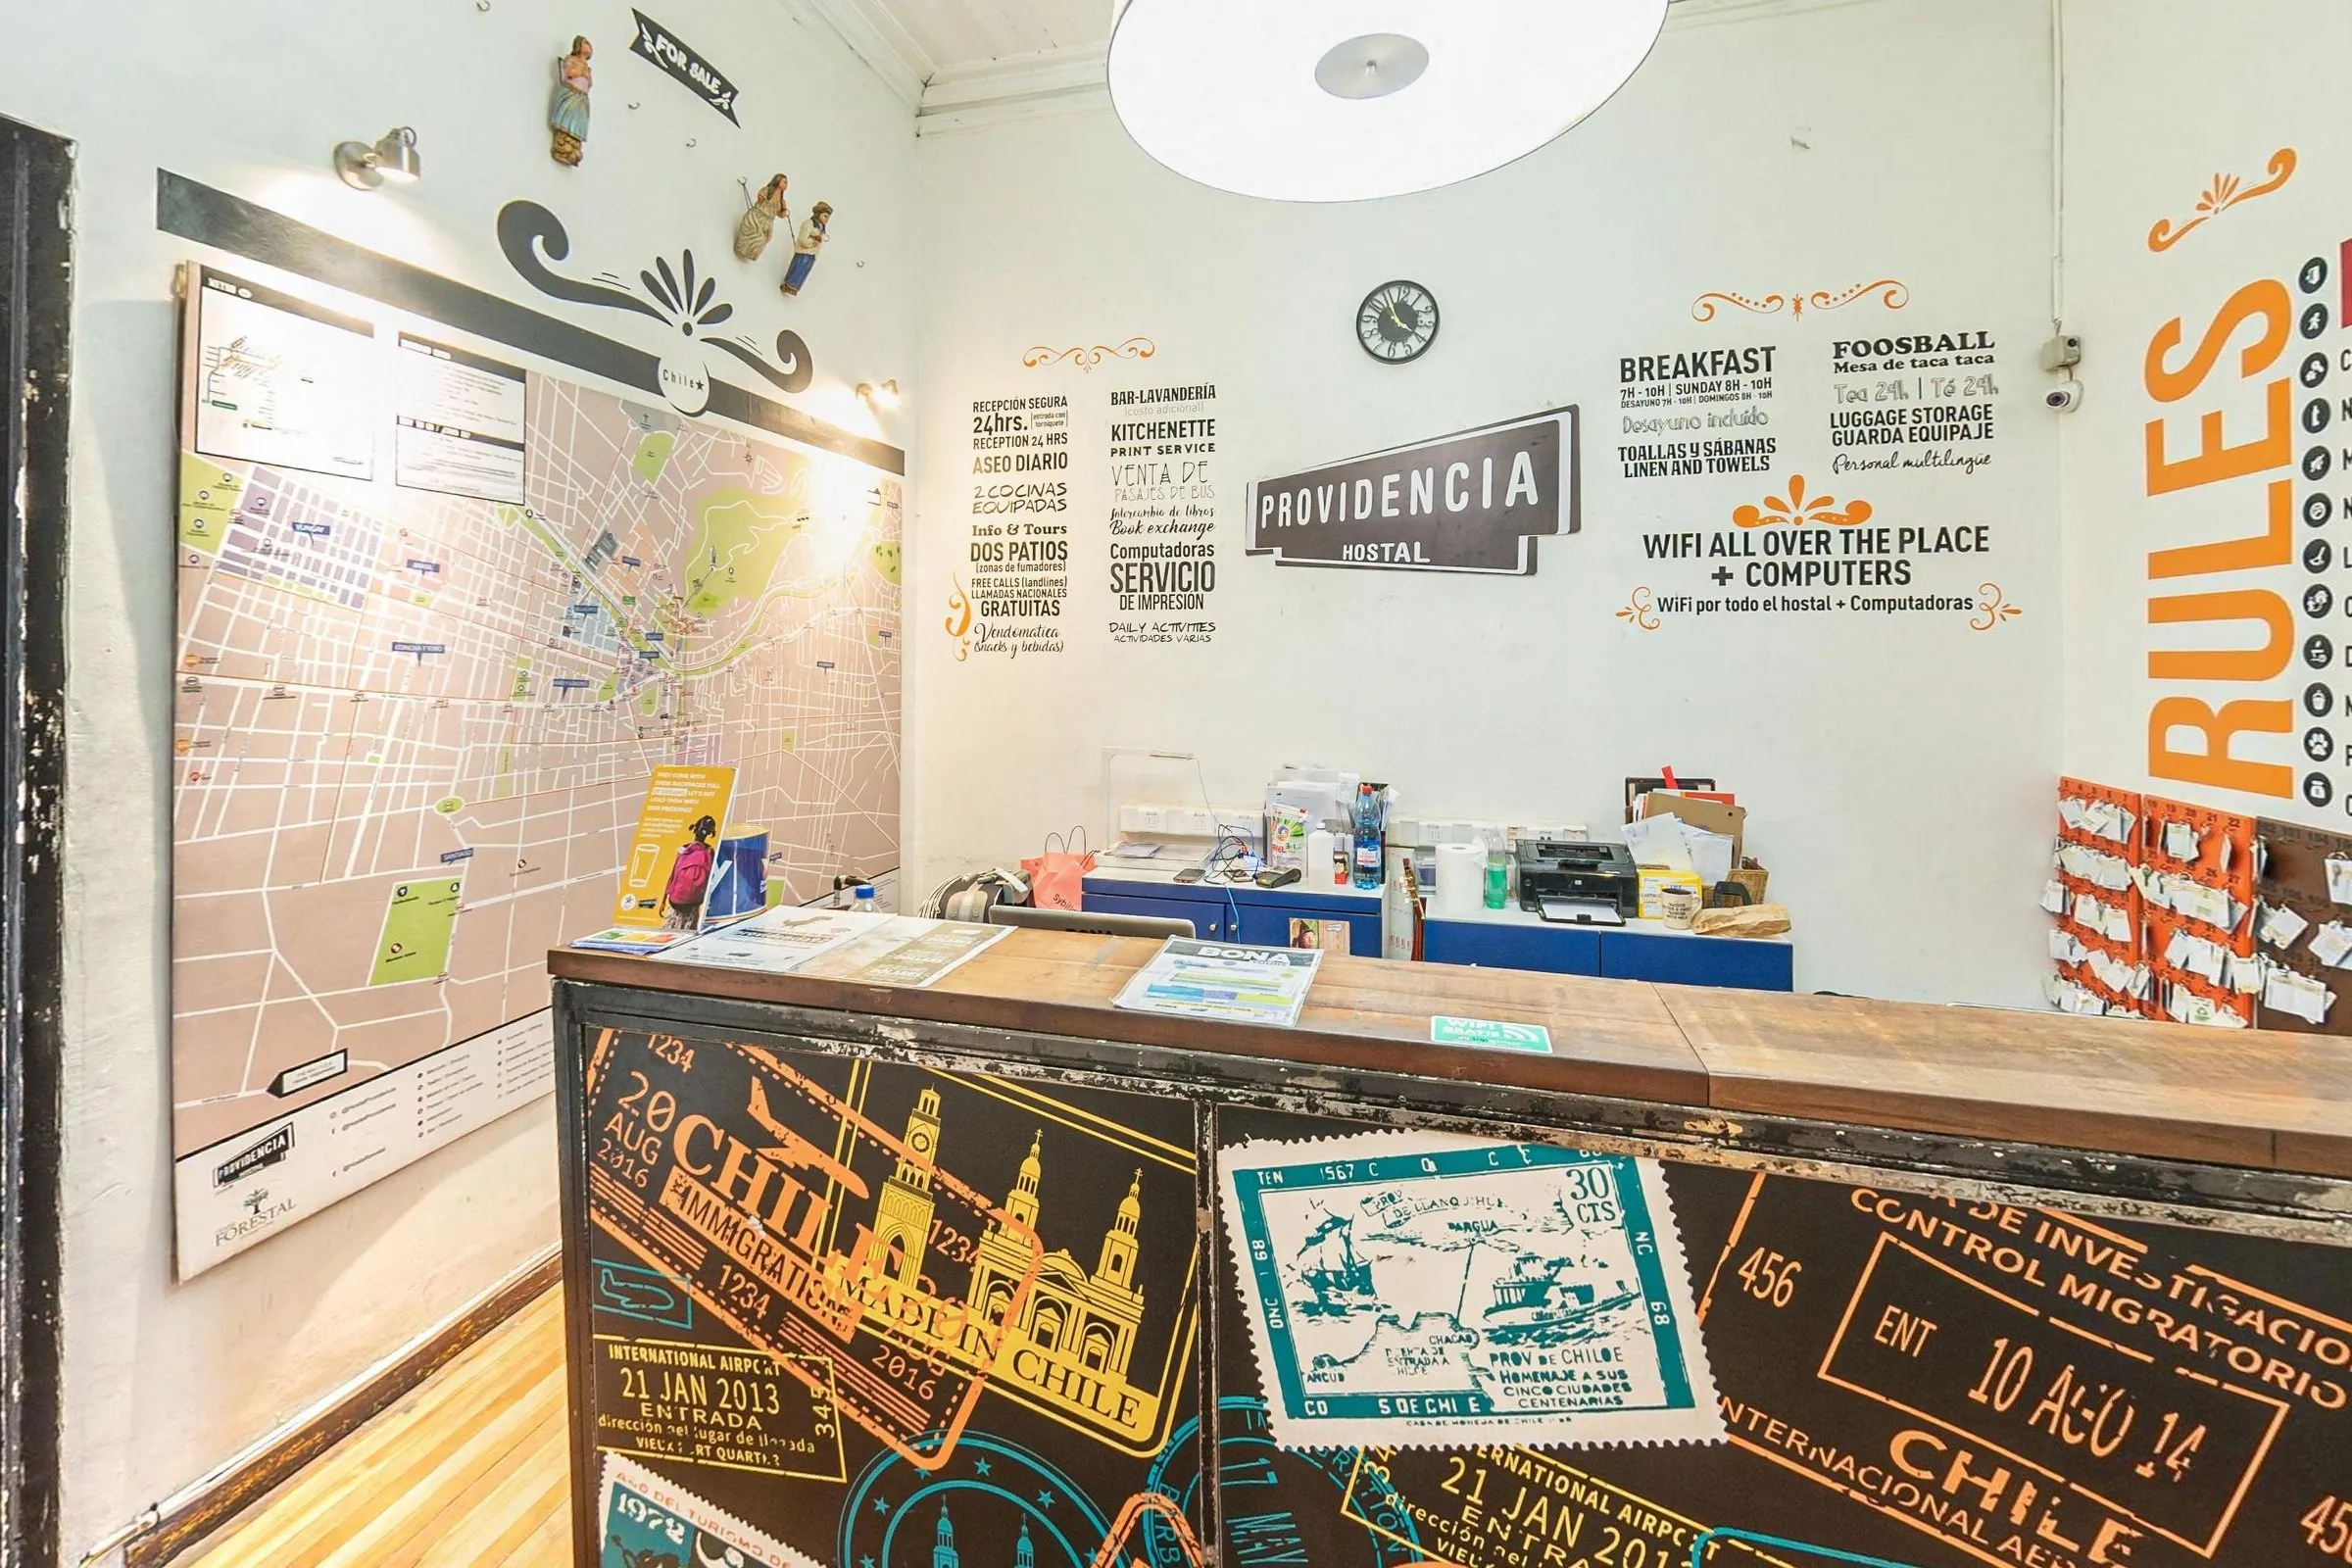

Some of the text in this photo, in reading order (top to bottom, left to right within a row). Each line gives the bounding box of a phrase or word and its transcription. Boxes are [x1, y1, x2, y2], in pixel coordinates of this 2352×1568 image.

[656, 33, 722, 95] FOR SALE
[1832, 330, 1996, 360] FOOSBALL
[1620, 345, 1777, 383] BREAKFAST
[1834, 354, 1995, 374] Mesa de taca taca
[662, 368, 694, 388] Chile
[1620, 376, 1773, 400] 7H 10H SUNDAY 8H 10H
[1110, 382, 1217, 406] BAR-LAVANDERÍA
[1620, 393, 1740, 409] DESAYUNO DOMINGOS
[1834, 383, 1869, 405] Tea
[1931, 377, 1956, 399] Té
[973, 395, 1068, 413] RECEPCIÓN SEGURA
[1830, 403, 1993, 429] LUGGAGE STORAGE
[973, 412, 1028, 436] 24hrs.
[1111, 418, 1216, 442] KITCHENETTE
[1623, 405, 1770, 437] Desayuno incluido
[973, 432, 1068, 450] RECEPTION 24 HRS
[1832, 422, 1994, 447] GUARDA EQUIPAJE
[972, 451, 1068, 474] ASEO DIARIO
[1110, 443, 1216, 458] PRINT SERVICE
[1618, 437, 1777, 463] TOALLAS SÁBANAS
[1832, 449, 1992, 475] Personal multilingüe
[1111, 461, 1208, 486] VENTA DE
[1624, 455, 1770, 478] LINEN AND TOWELS
[973, 482, 1067, 500] 2 COCINAS
[1114, 484, 1215, 503] PASAJES DE BUS
[1261, 451, 1539, 529] PROVIDENCIA
[972, 498, 1067, 514] EQUIPADAS
[1169, 505, 1180, 517] de
[1185, 504, 1215, 517] libros
[972, 523, 1067, 536] Info & Tours
[1109, 518, 1216, 541] Book exchange
[1642, 525, 1990, 559] WIFI ALL OVER THE PLACE
[2143, 277, 2295, 800] RULES
[970, 540, 1068, 563] DOS PATIOS
[1109, 541, 1215, 562] Computadoras
[1342, 541, 1431, 564] HOSTAL
[1004, 562, 1015, 572] de
[1017, 560, 1066, 573] fumadores)
[1109, 560, 1216, 594] SERVICIO
[1745, 559, 1912, 588] COMPUTERS
[971, 577, 992, 588] FREE
[993, 577, 1020, 588] CALLS
[971, 588, 1068, 600] LLAMADAS NACIONALES
[981, 600, 1060, 617] GRATUITAS
[1119, 590, 1204, 611] DE IMPRESIÓN
[1657, 593, 1974, 616] WiFi por todo el hostal Computadoras
[1108, 621, 1147, 634] DAILY
[1113, 634, 1212, 643] ACTIVIDADES VARIAS
[1198, 946, 1291, 966] BONA
[648, 1034, 696, 1073] 1234
[617, 1071, 676, 1132] 20
[604, 1111, 662, 1165] AUG
[218, 1133, 287, 1182] PROVIDENCIA
[596, 1138, 650, 1189] 2016
[1566, 1166, 1610, 1201] 30
[673, 1114, 906, 1301] CHILE
[1576, 1200, 1617, 1224] CTS
[214, 1198, 297, 1249] FORESTAL
[1738, 1247, 1802, 1308] 456
[719, 1263, 770, 1321] 1234
[1850, 1188, 2346, 1410] CONTROL MIGRATORIO
[1875, 1304, 1937, 1358] ENT
[609, 1345, 715, 1370] INTERNATIONAL
[840, 1275, 1141, 1429] MADE IN CHILE
[1490, 1347, 1625, 1368] PROV DE CHILOE
[871, 1344, 937, 1401] 2016
[1500, 1369, 1629, 1386] HOMENAJE A SUS
[620, 1367, 781, 1416] 21 JAN 2013
[1503, 1382, 1634, 1397] CINCO CIUDADES
[1519, 1396, 1625, 1409] CENTENARIAS
[1968, 1338, 2034, 1412] 10
[2134, 1411, 2207, 1483] 14
[640, 1401, 762, 1432] ENTRADA
[598, 1413, 754, 1446] dirección de
[1441, 1455, 1487, 1506] 21
[1501, 1487, 1585, 1548] JAN
[1888, 1429, 2150, 1566] CHILE
[1385, 1491, 1486, 1551] dirección
